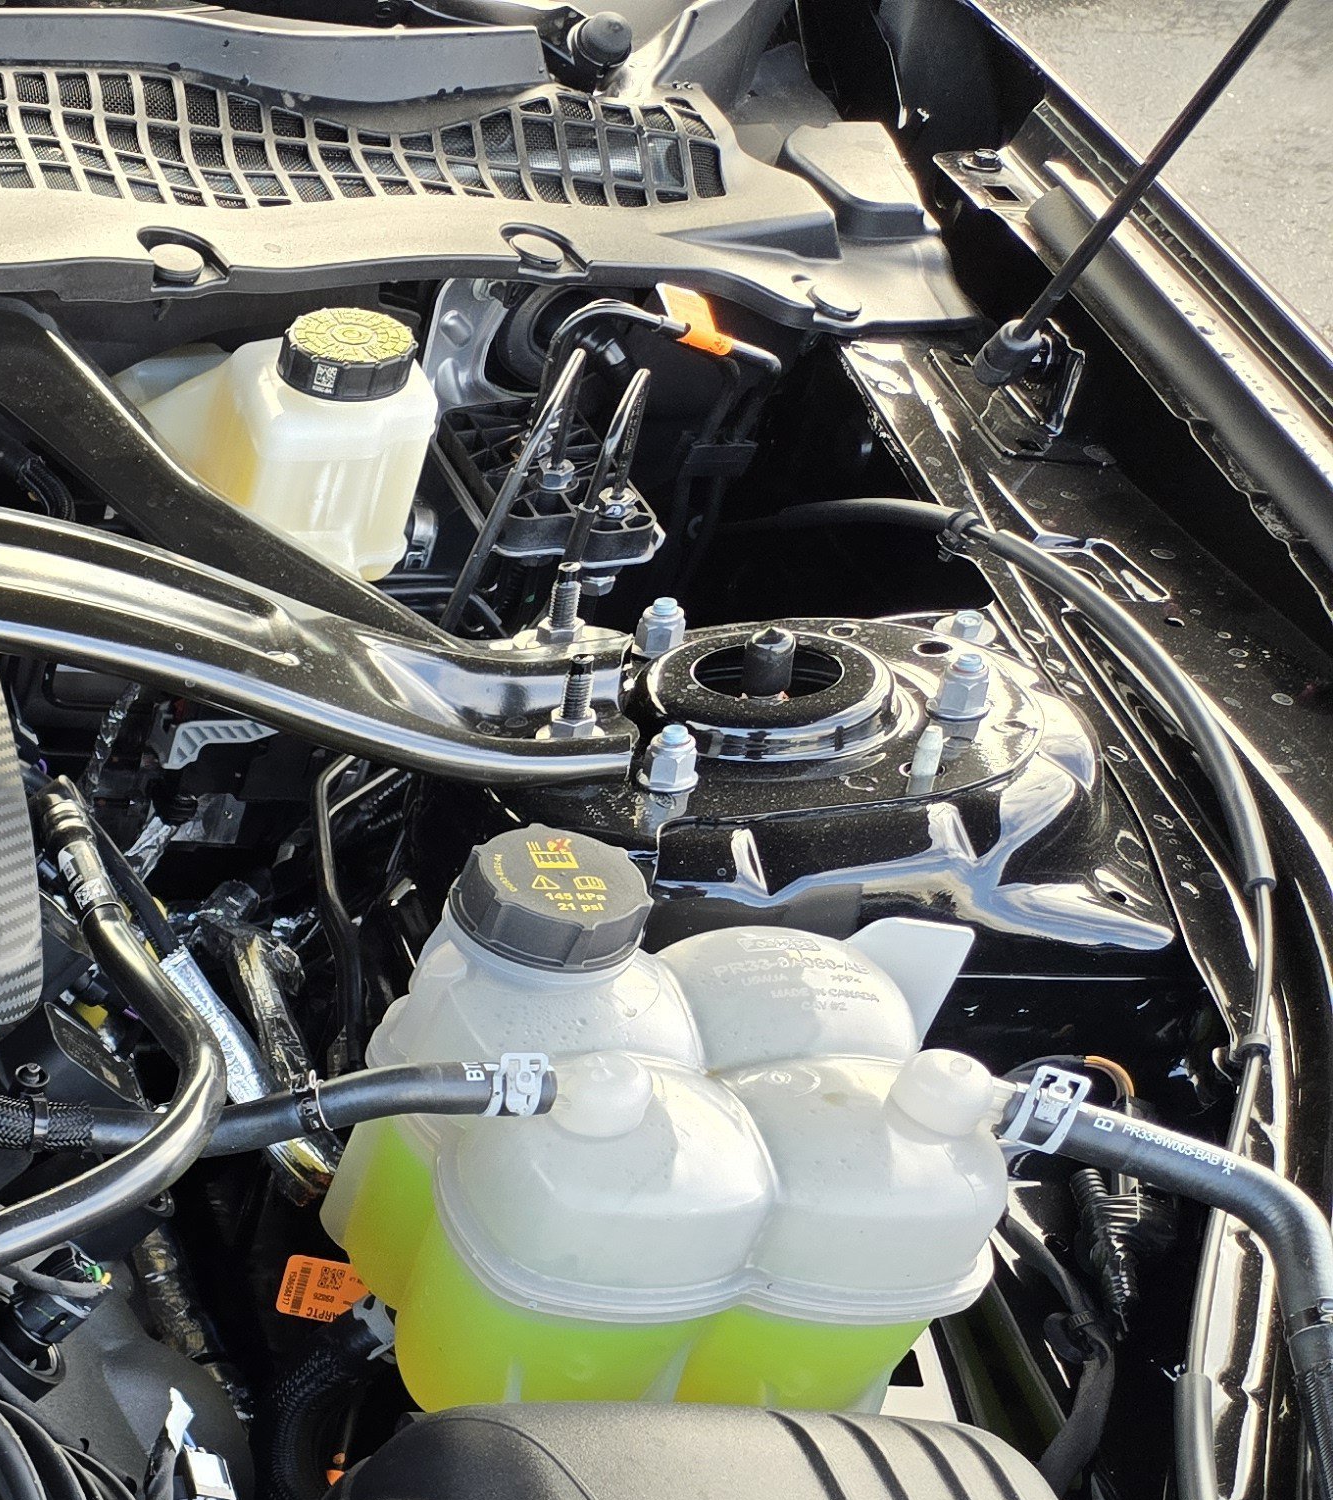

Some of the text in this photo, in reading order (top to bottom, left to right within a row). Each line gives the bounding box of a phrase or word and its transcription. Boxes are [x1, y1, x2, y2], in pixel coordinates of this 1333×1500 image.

[545, 892, 607, 901] 145 kPa
[557, 902, 605, 913] 21 psi
[770, 987, 811, 999] MADE
[828, 987, 881, 1003] CANADA
